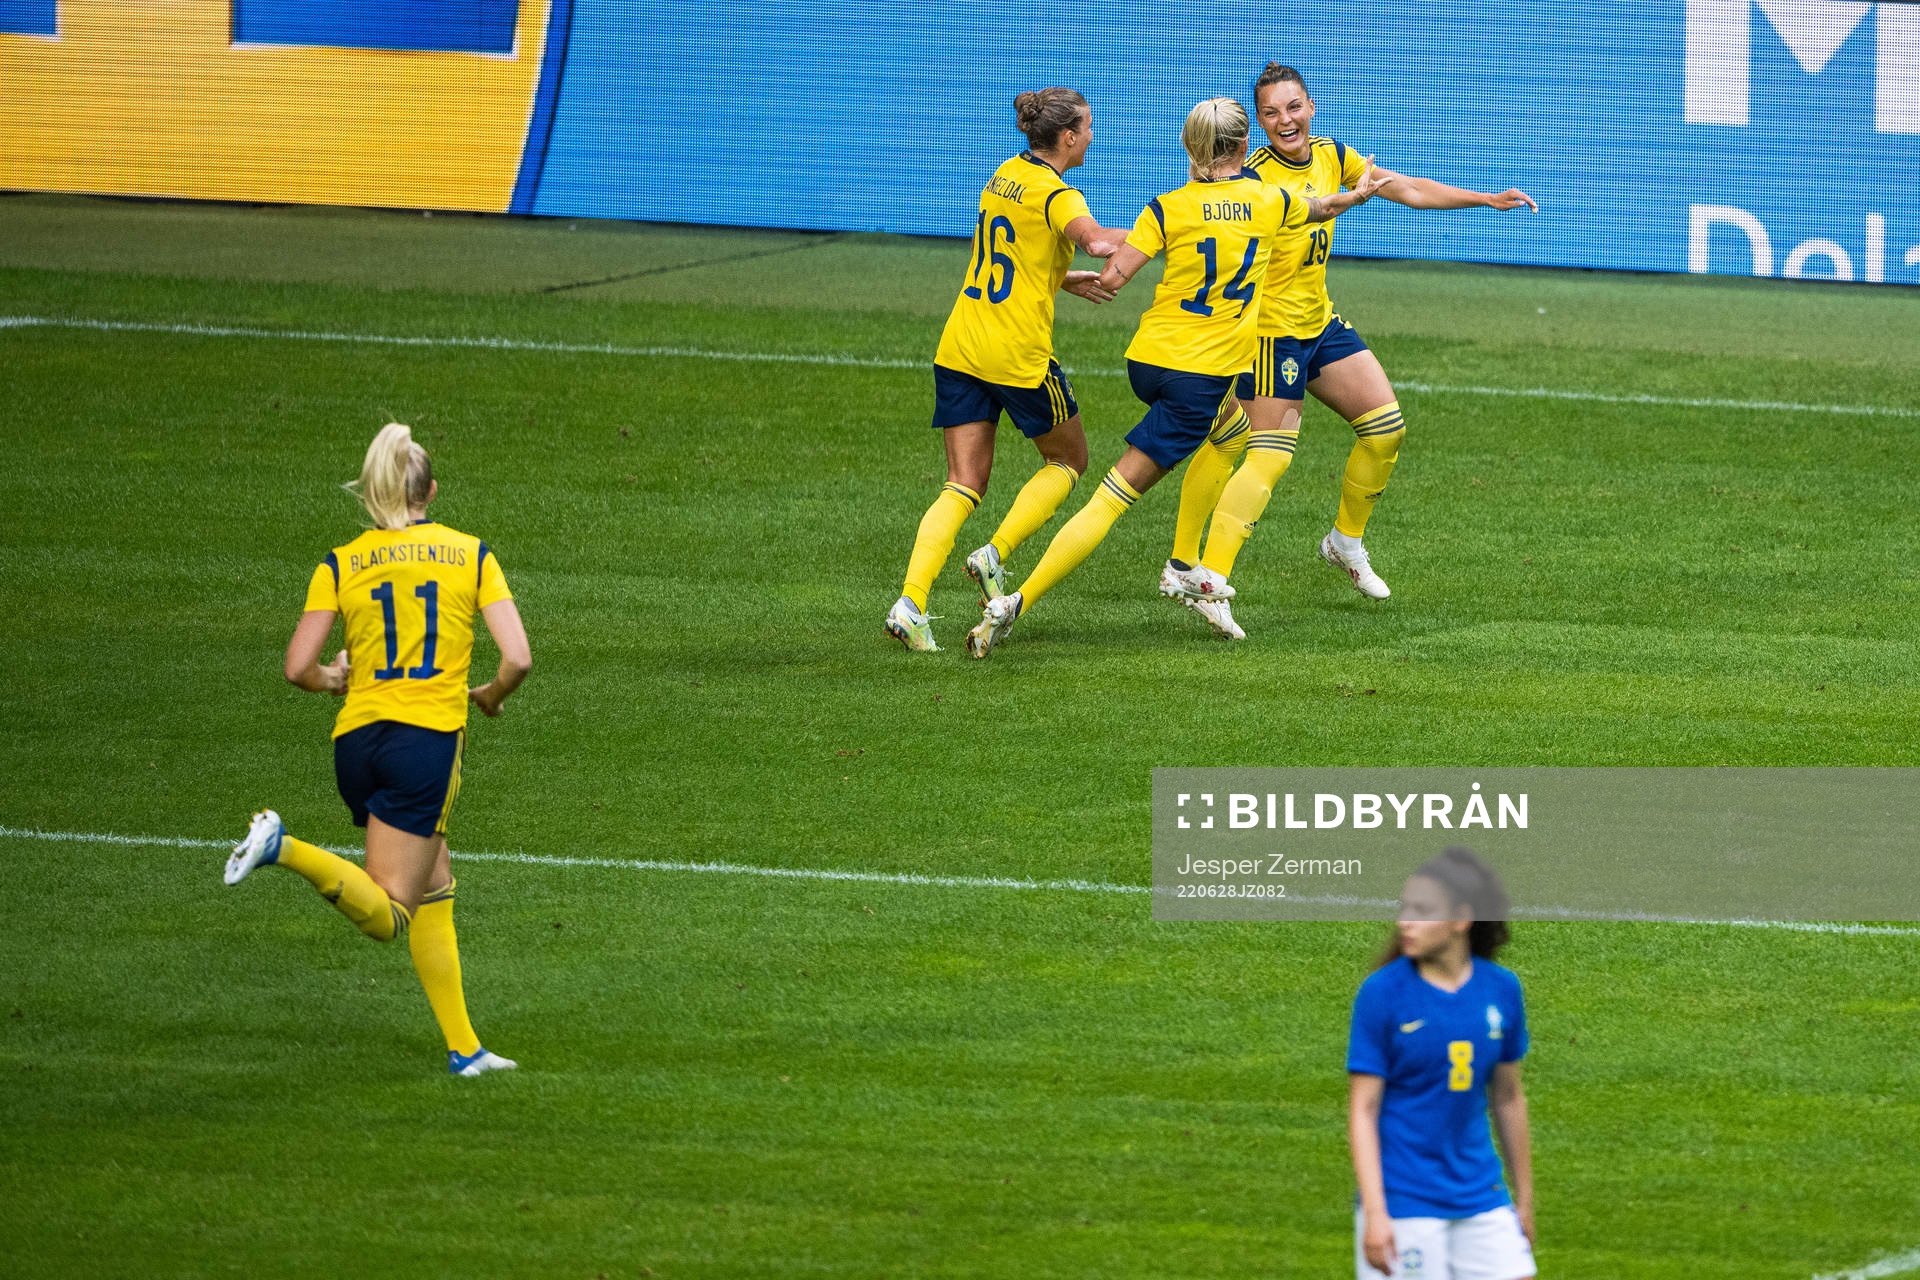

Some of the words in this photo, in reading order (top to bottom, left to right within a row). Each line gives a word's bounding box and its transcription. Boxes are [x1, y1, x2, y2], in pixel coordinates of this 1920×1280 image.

[1202, 200, 1252, 222] BJÖRN
[963, 209, 1016, 305] 16
[1302, 228, 1329, 267] 19
[1180, 237, 1260, 319] 14
[350, 543, 467, 573] BLACKSTENIUS
[370, 580, 444, 681] 11
[1447, 1040, 1475, 1092] 8
